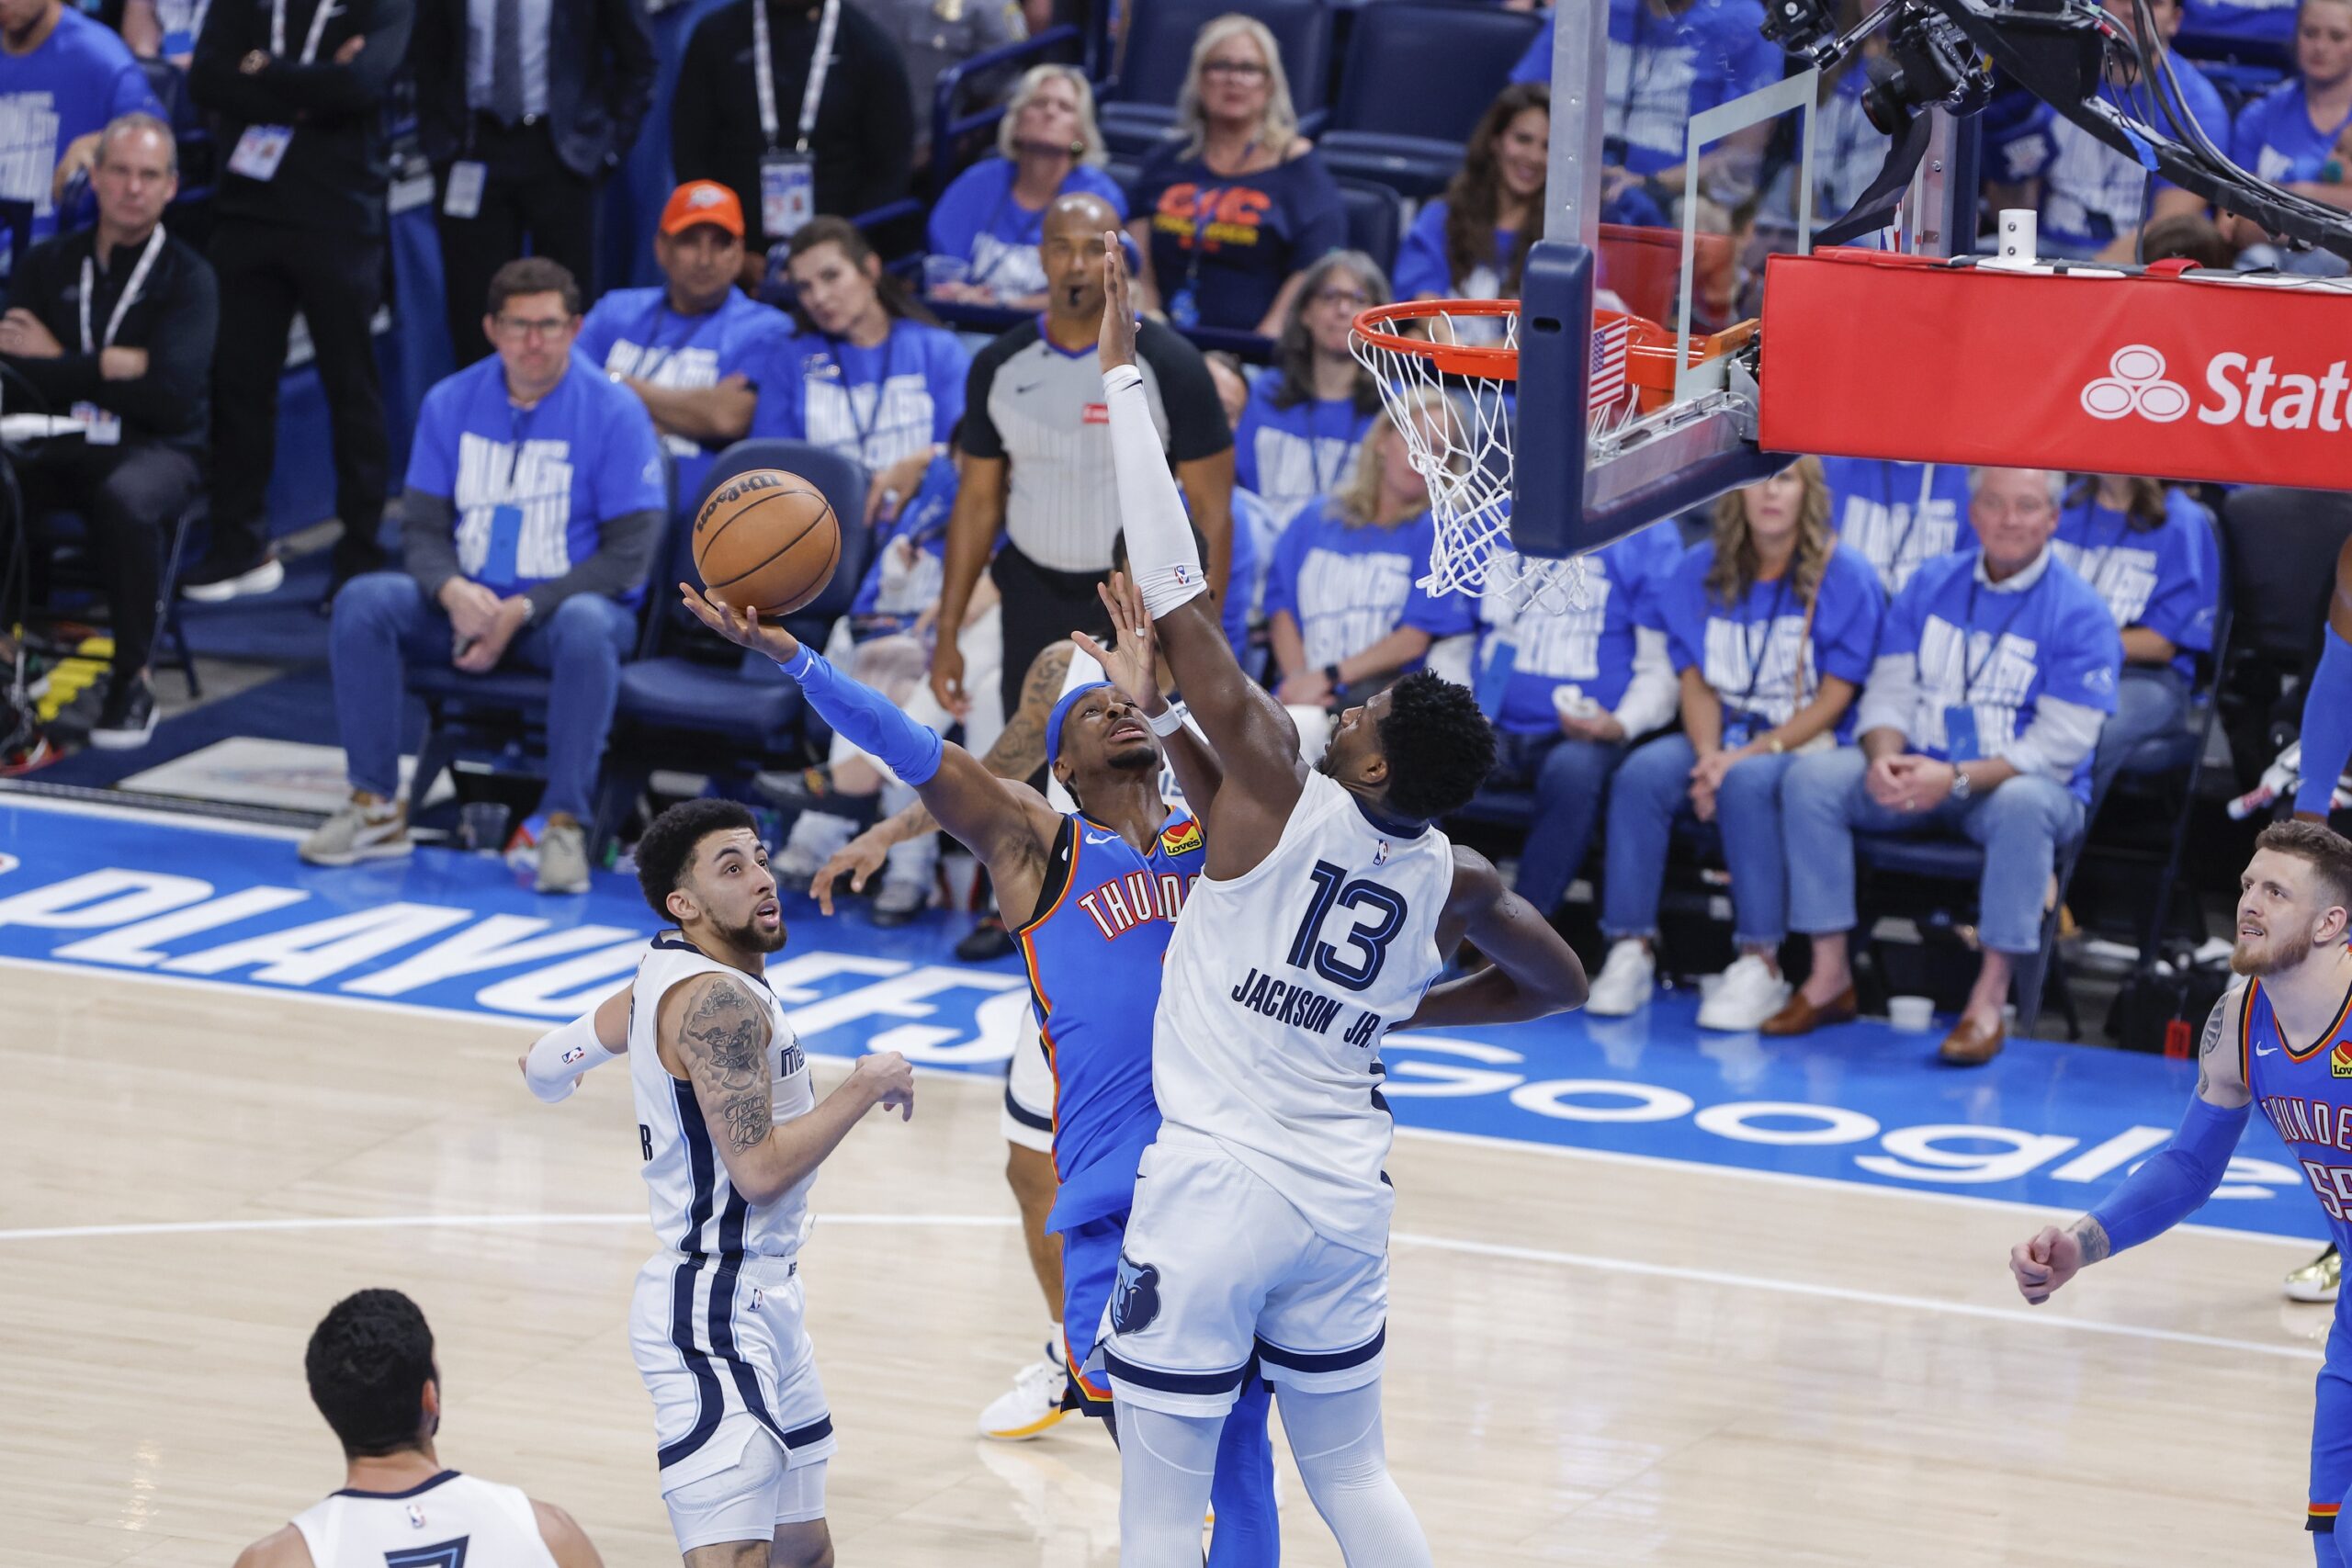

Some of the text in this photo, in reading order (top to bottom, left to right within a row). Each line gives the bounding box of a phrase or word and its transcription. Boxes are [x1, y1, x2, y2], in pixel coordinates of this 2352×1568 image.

[2197, 351, 2352, 432] Stat
[1286, 859, 1408, 991] 13
[1231, 967, 1344, 1035] JACKSON
